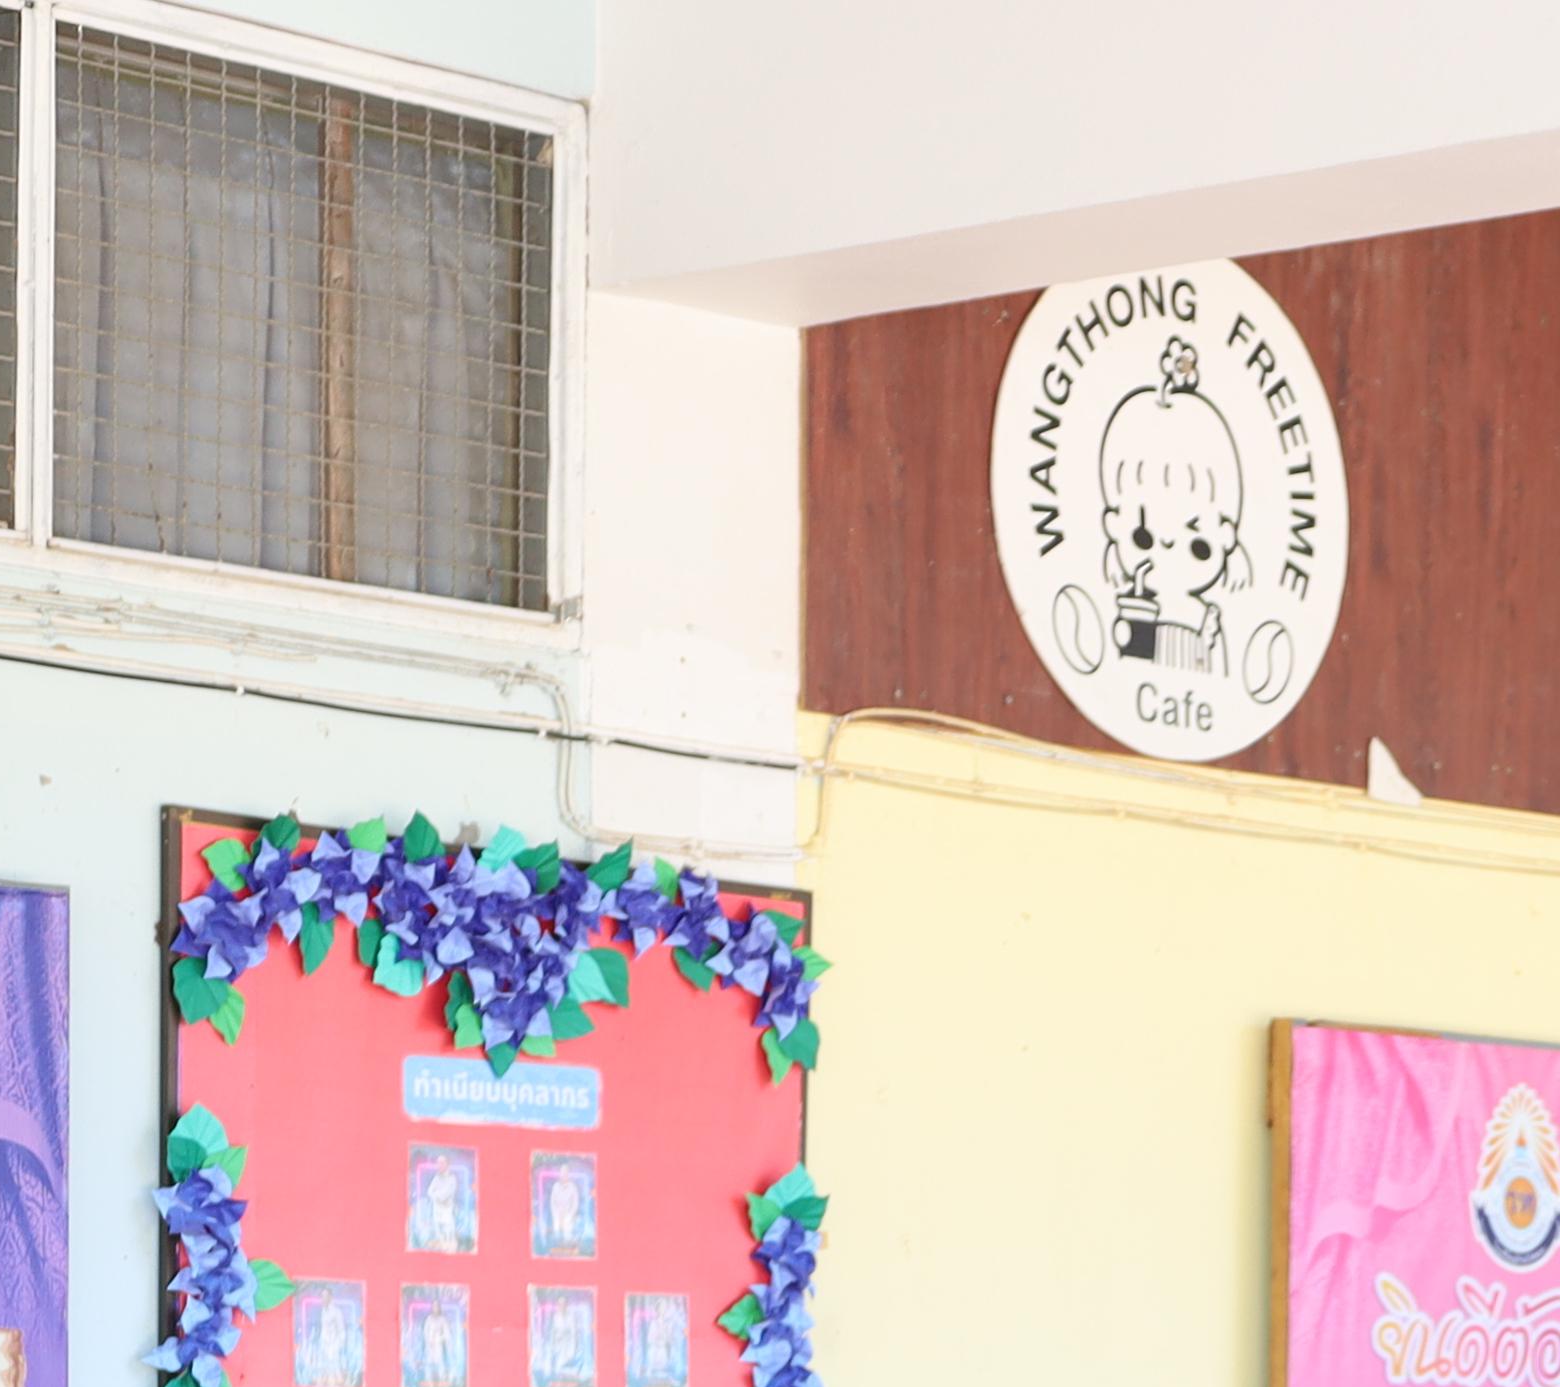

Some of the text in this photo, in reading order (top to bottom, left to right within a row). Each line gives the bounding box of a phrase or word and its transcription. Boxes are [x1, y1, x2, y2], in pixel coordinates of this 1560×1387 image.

[1029, 275, 1316, 602] WANGTHONG FREETIME
[1136, 682, 1214, 732] Cafe
[413, 1069, 590, 1113] ทำเนียบบุคลากร
